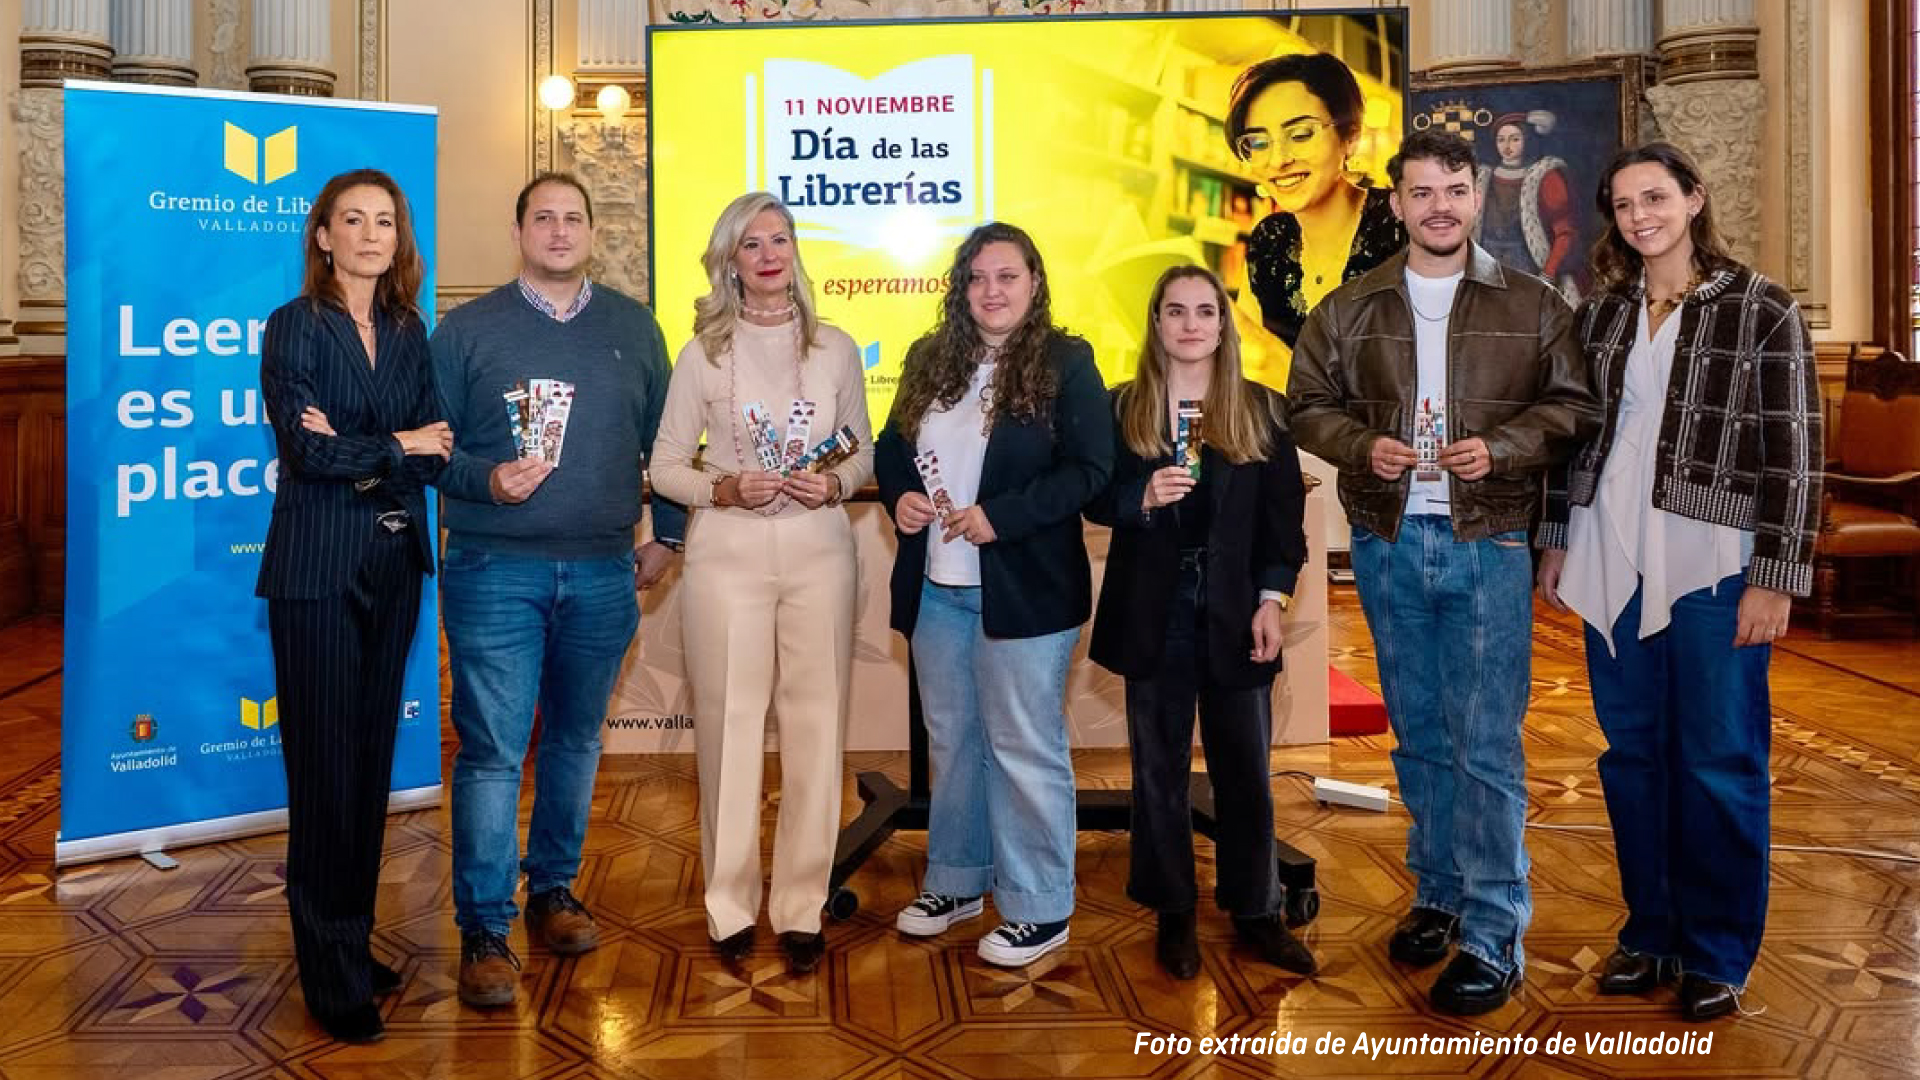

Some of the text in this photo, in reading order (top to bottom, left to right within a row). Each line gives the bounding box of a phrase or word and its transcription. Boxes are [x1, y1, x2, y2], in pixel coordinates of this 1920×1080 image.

[785, 95, 955, 116] 11 NOVIEMBRE
[790, 126, 949, 161] Día de las
[778, 171, 962, 206] Librerías
[149, 191, 235, 213] Gremio
[243, 195, 269, 213] de
[824, 277, 952, 301] esperamos
[117, 389, 195, 429] es
[200, 739, 248, 755] Gremio
[251, 735, 266, 748] de
[111, 753, 177, 773] Valladolid
